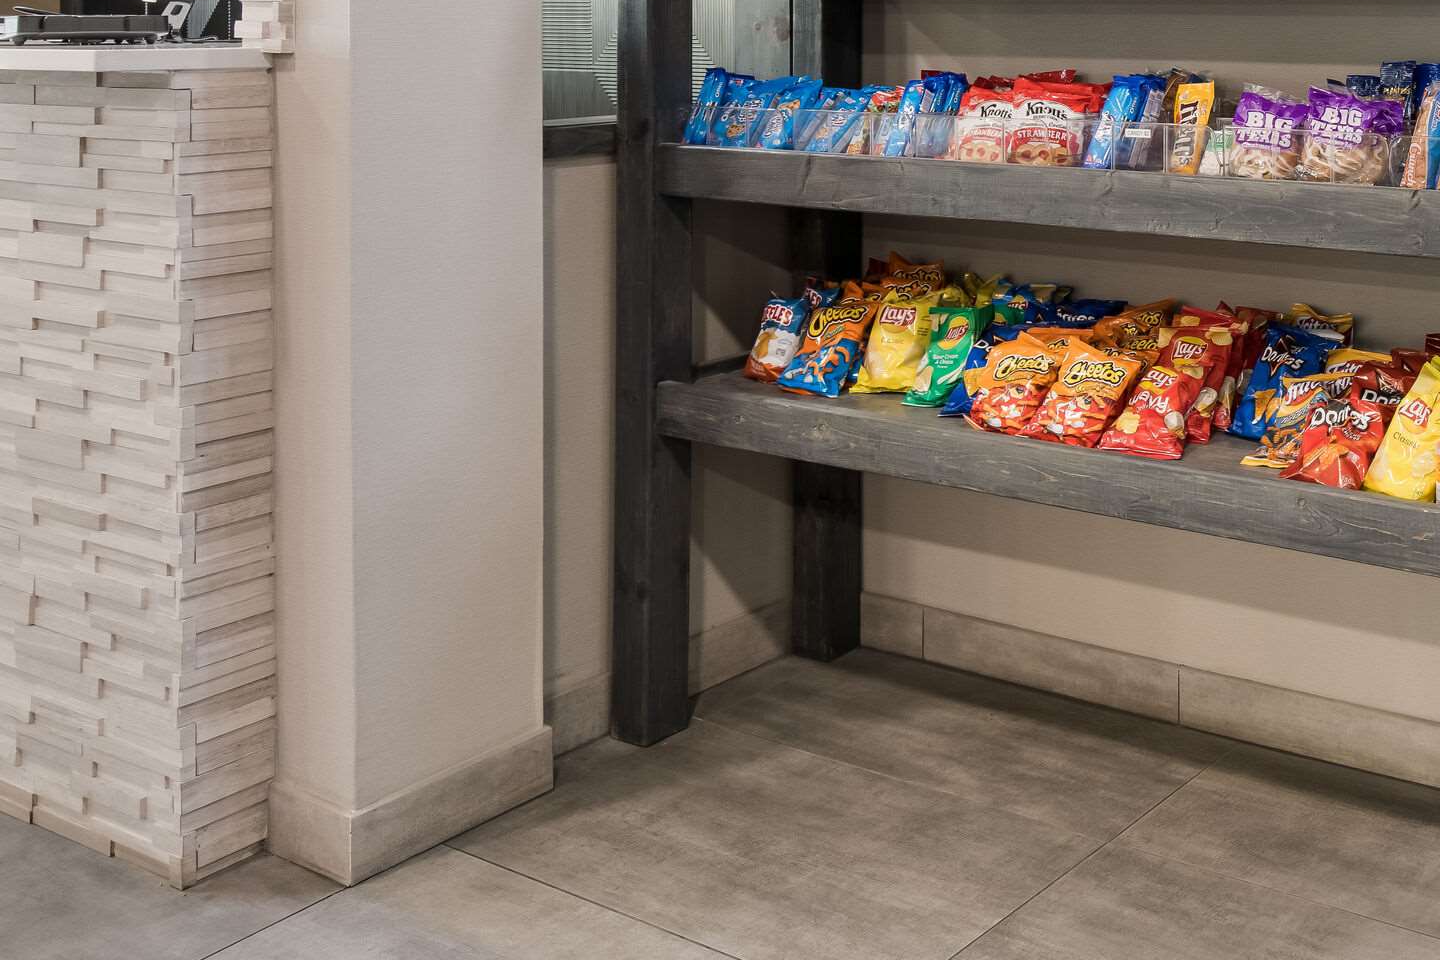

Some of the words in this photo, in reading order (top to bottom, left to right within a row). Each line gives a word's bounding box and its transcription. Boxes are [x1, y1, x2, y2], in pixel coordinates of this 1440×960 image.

[980, 103, 1013, 119] Knott's
[1026, 101, 1068, 121] Knott's
[1246, 111, 1293, 131] BIG
[1324, 107, 1363, 126] BIG
[1236, 128, 1292, 148] TEXAS
[1311, 118, 1364, 145] TEXAS
[808, 306, 867, 337] Cheetos
[994, 355, 1055, 380] Cheetos
[1260, 346, 1305, 371] Doritos
[1064, 360, 1128, 386] Cheetos
[1310, 404, 1371, 431] Doritos
